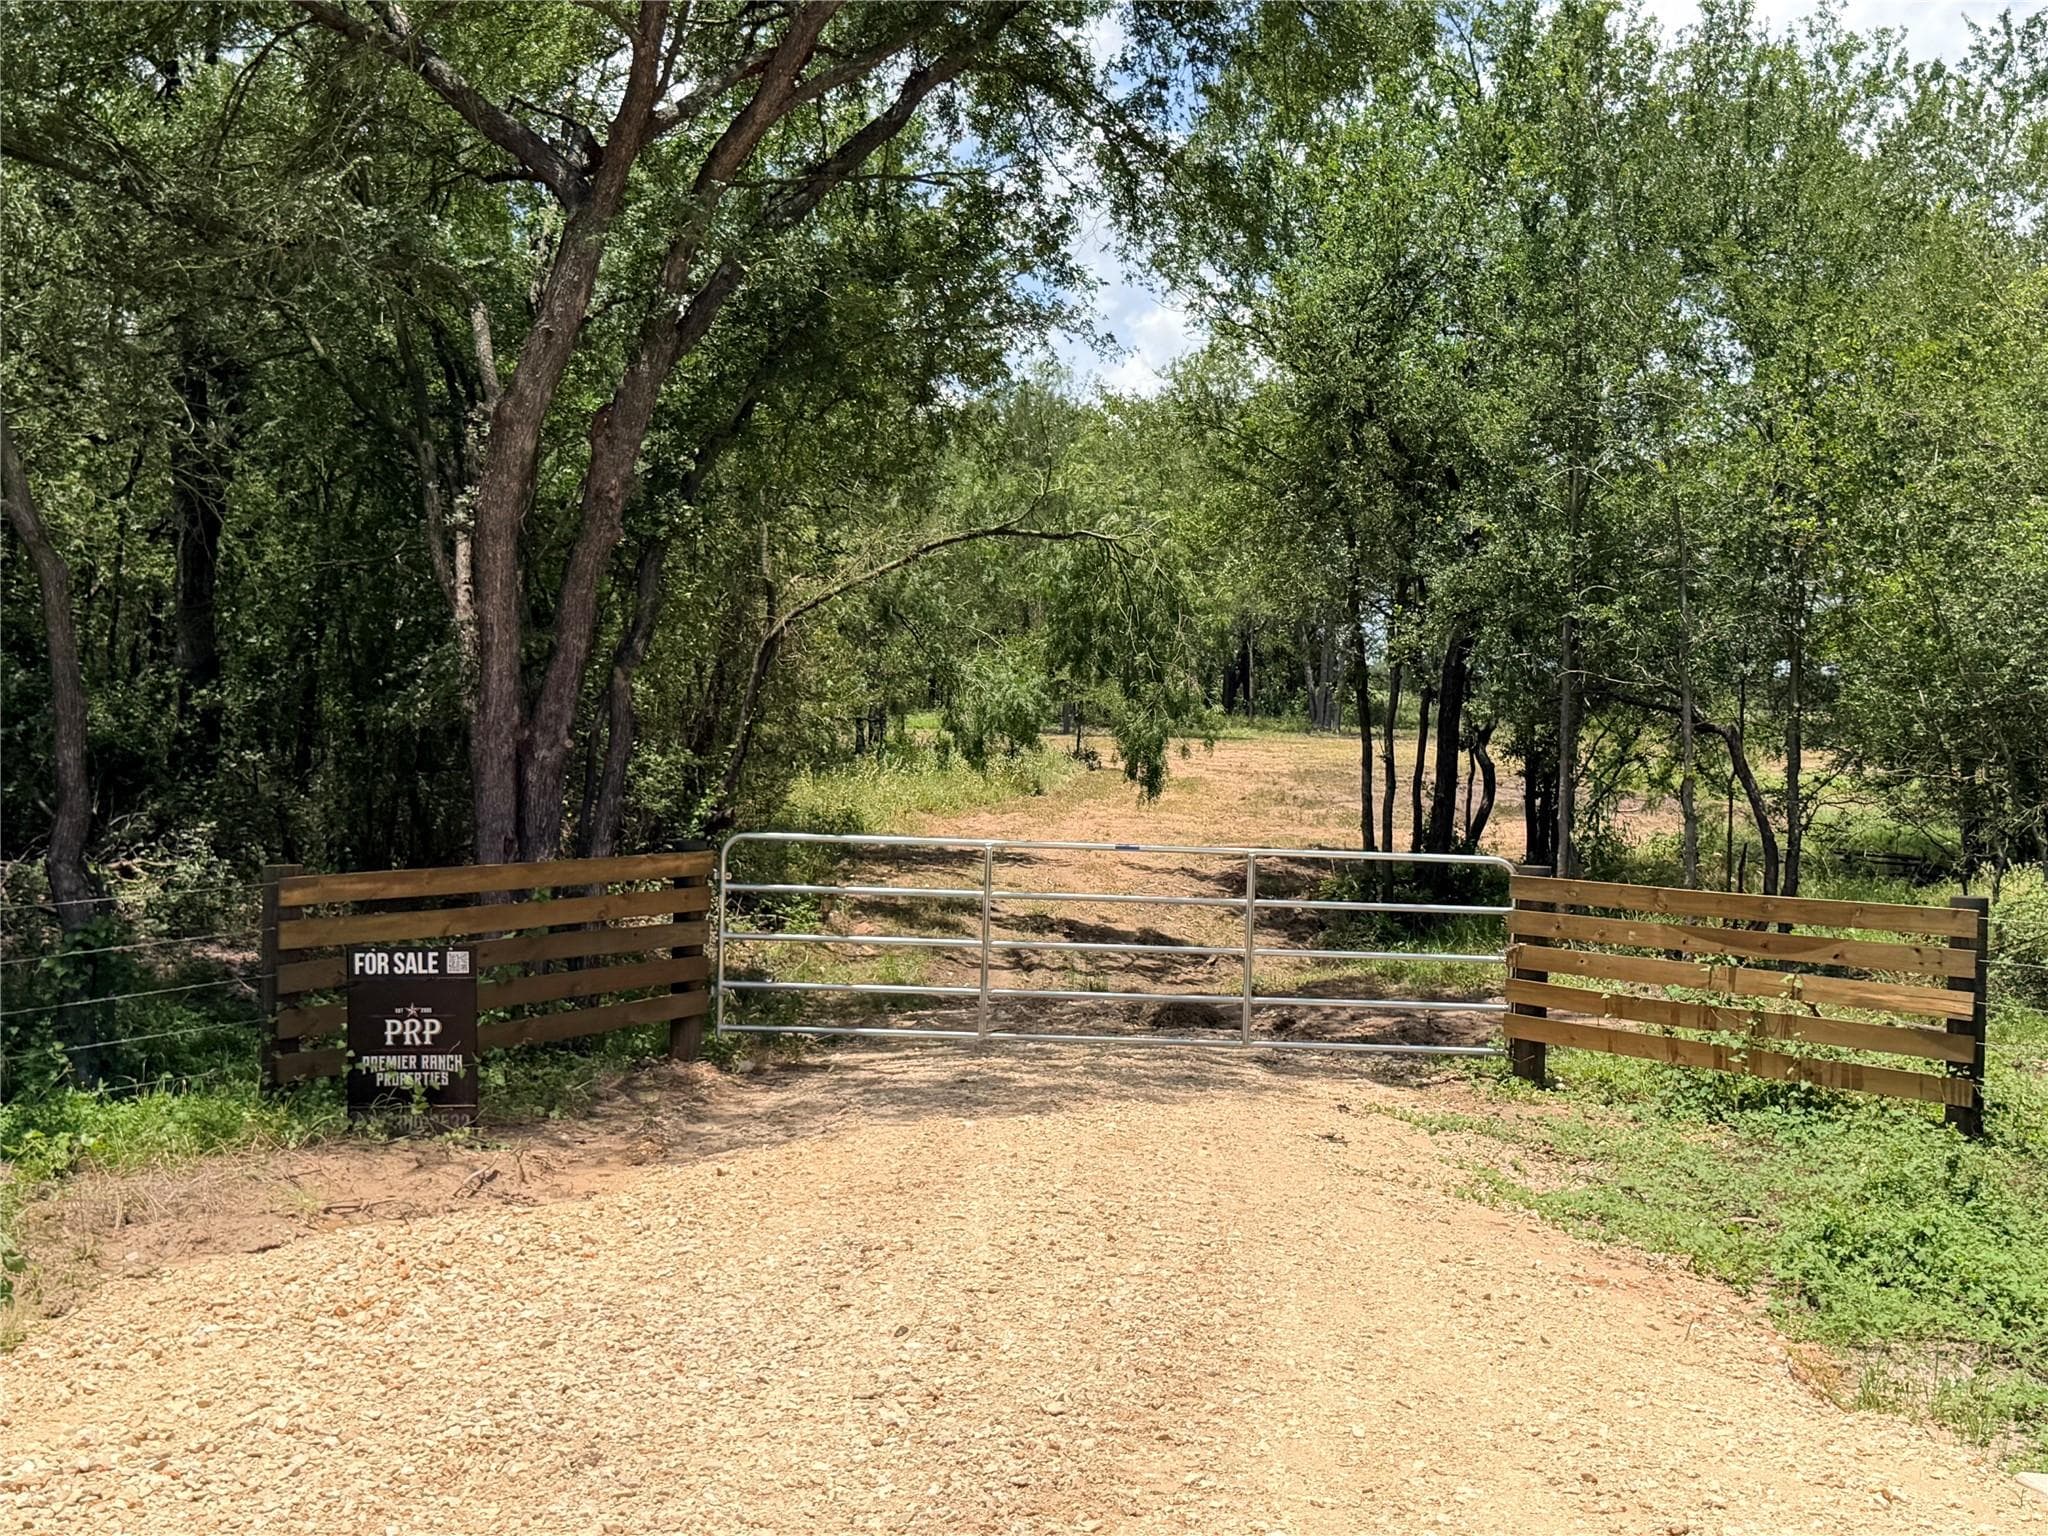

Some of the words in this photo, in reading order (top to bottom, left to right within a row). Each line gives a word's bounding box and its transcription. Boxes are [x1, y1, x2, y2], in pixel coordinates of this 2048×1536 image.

[354, 952, 389, 975] FOR
[393, 951, 439, 975] SALE
[384, 1018, 443, 1046] PRP
[362, 1055, 417, 1075] PREMIER
[421, 1054, 463, 1073] RANCH
[376, 1071, 449, 1087] PROPRTIES
